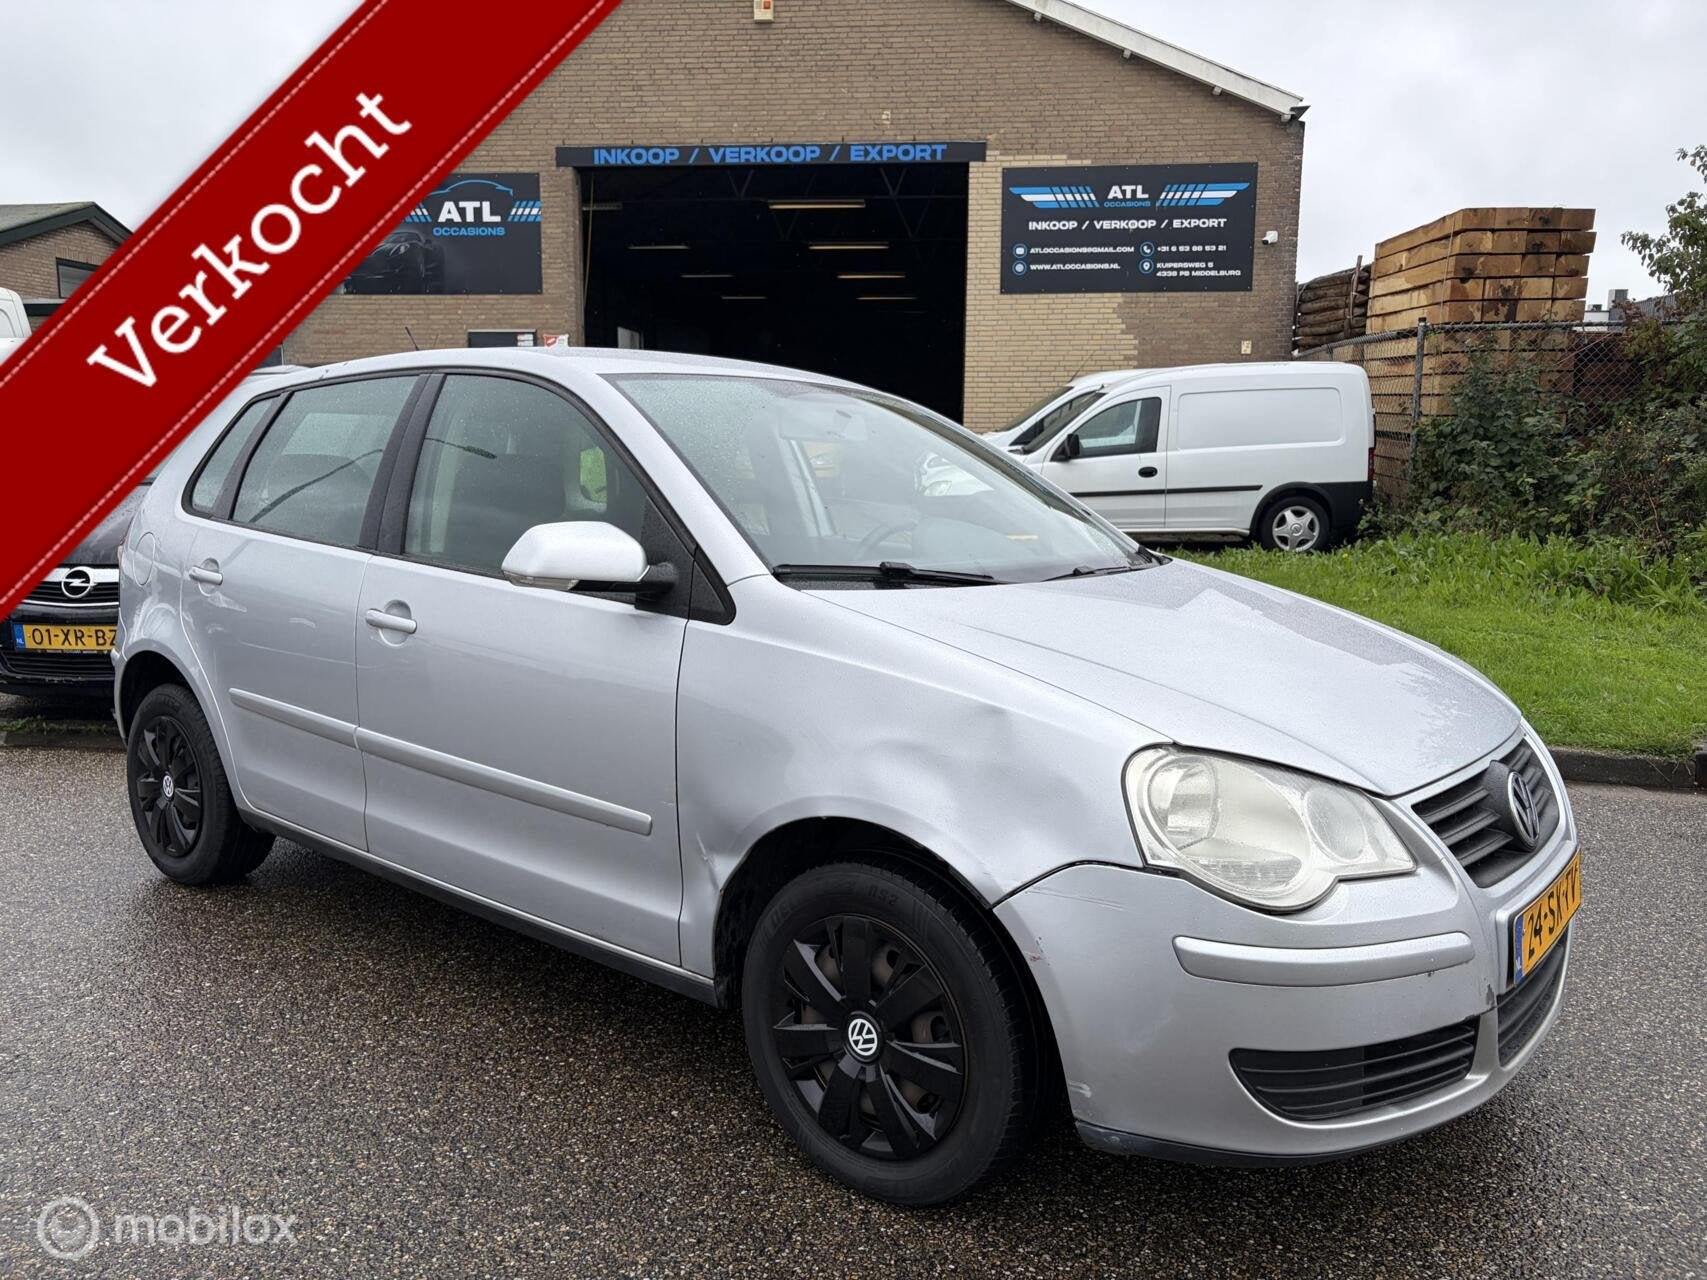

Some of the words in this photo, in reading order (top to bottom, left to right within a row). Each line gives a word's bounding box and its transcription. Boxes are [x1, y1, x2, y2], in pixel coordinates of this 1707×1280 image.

[593, 148, 680, 166] INKOOP
[708, 147, 821, 164] VERKOOP
[849, 143, 948, 161] EXPORT
[1107, 184, 1149, 200] ATL
[1103, 200, 1151, 208] OCCASIONS
[437, 200, 502, 223] ATL
[432, 226, 506, 237] OCCASIONS
[1028, 220, 1078, 231] INKOOP
[1093, 219, 1157, 230] VERKOOP
[1172, 218, 1227, 229] EXPORT
